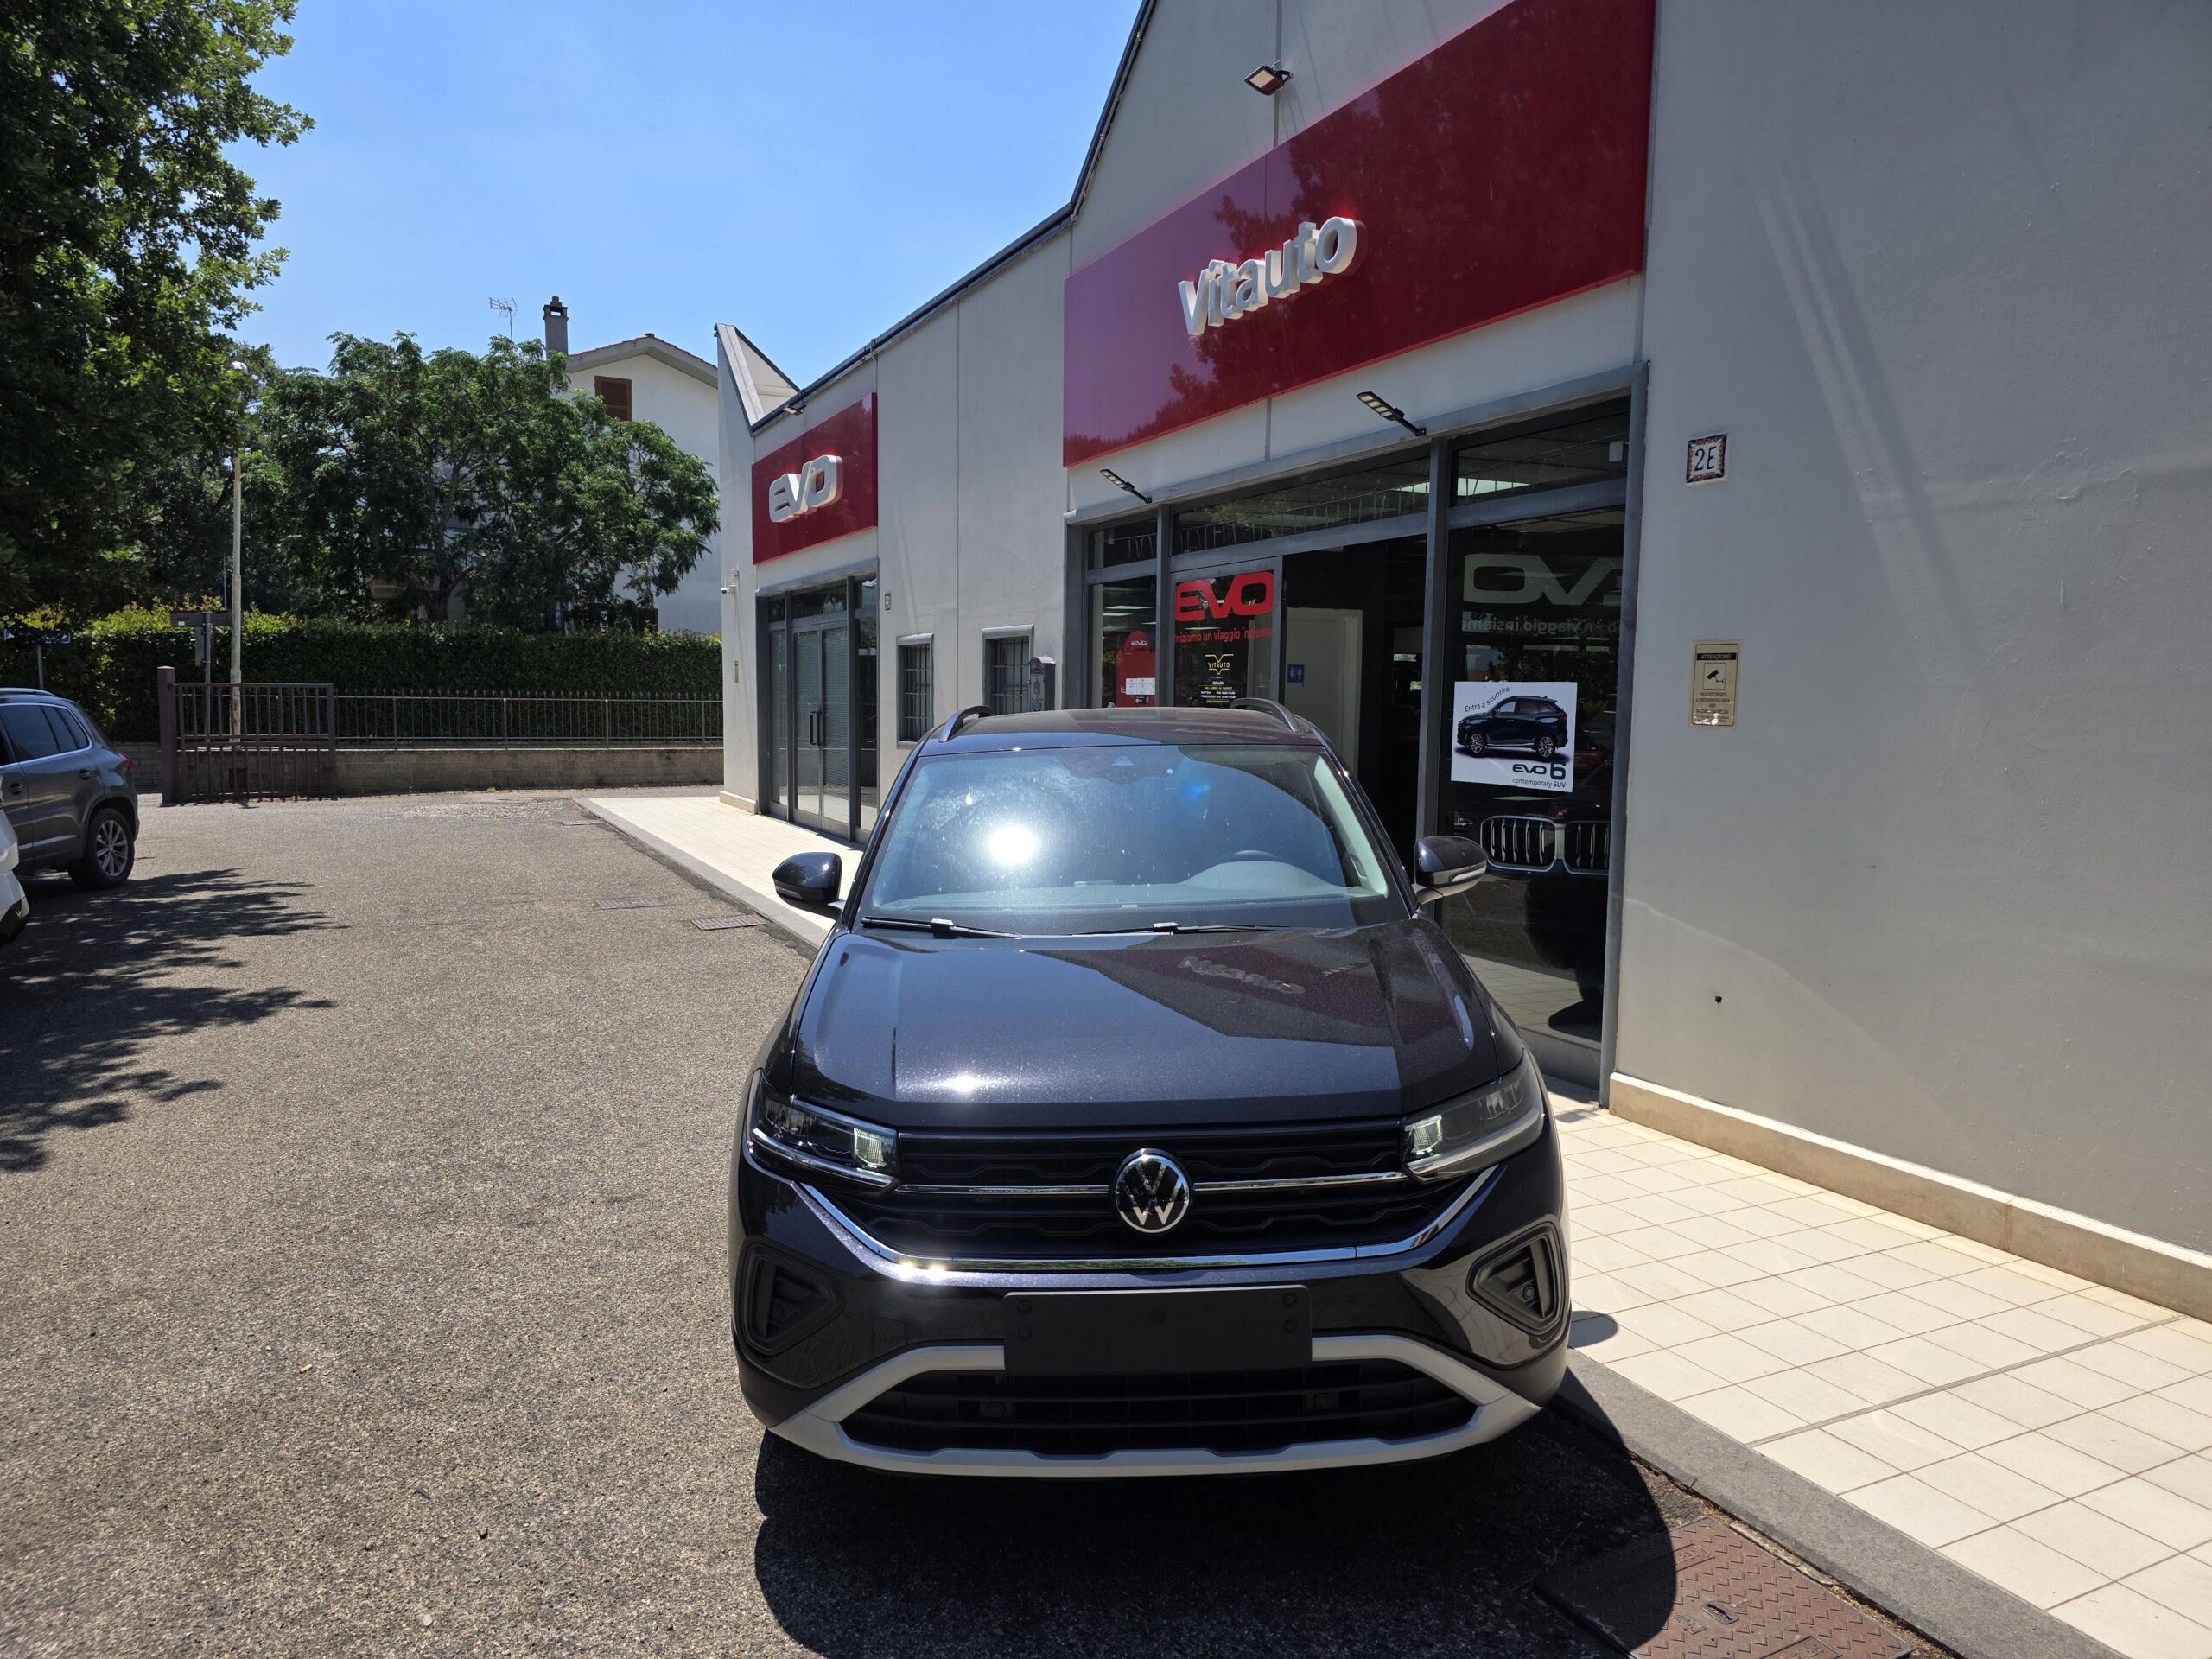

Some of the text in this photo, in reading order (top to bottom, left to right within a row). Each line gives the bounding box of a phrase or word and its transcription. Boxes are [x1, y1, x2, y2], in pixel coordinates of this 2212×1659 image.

[1178, 216, 1358, 336] Vitauto
[1694, 446, 1717, 472] 2E
[768, 454, 843, 523] EVO
[1175, 571, 1274, 621] EVO
[1203, 632, 1212, 641] un
[1213, 628, 1241, 643] viaggio
[1464, 703, 1480, 712] Entra
[1486, 686, 1510, 705] scoprire
[1512, 763, 1547, 774] EVO
[1550, 760, 1566, 780] 6
[1512, 777, 1553, 788] contemporary
